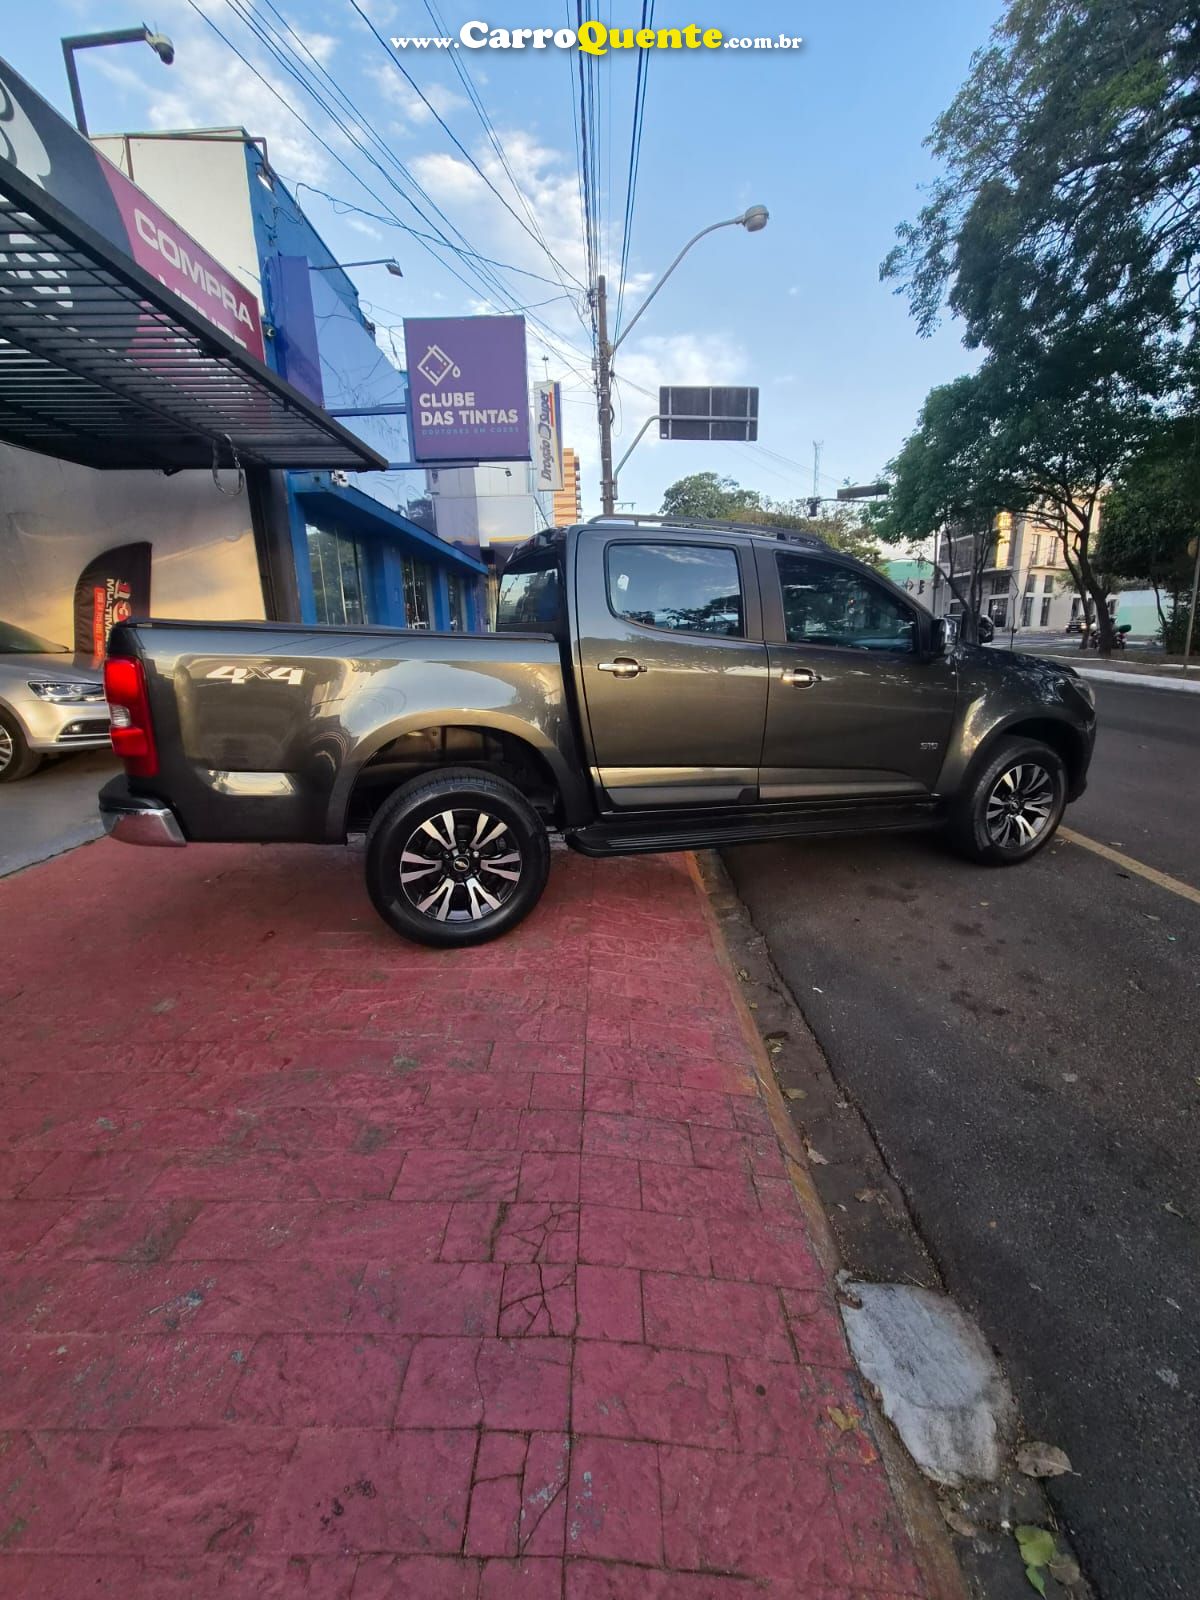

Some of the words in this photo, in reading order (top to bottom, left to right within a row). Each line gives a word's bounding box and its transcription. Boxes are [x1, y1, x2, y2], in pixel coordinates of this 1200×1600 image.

[134, 208, 255, 332] COMPRA
[419, 392, 476, 408] CLUBE
[421, 410, 455, 426] DAS
[459, 409, 519, 425] TINTAS
